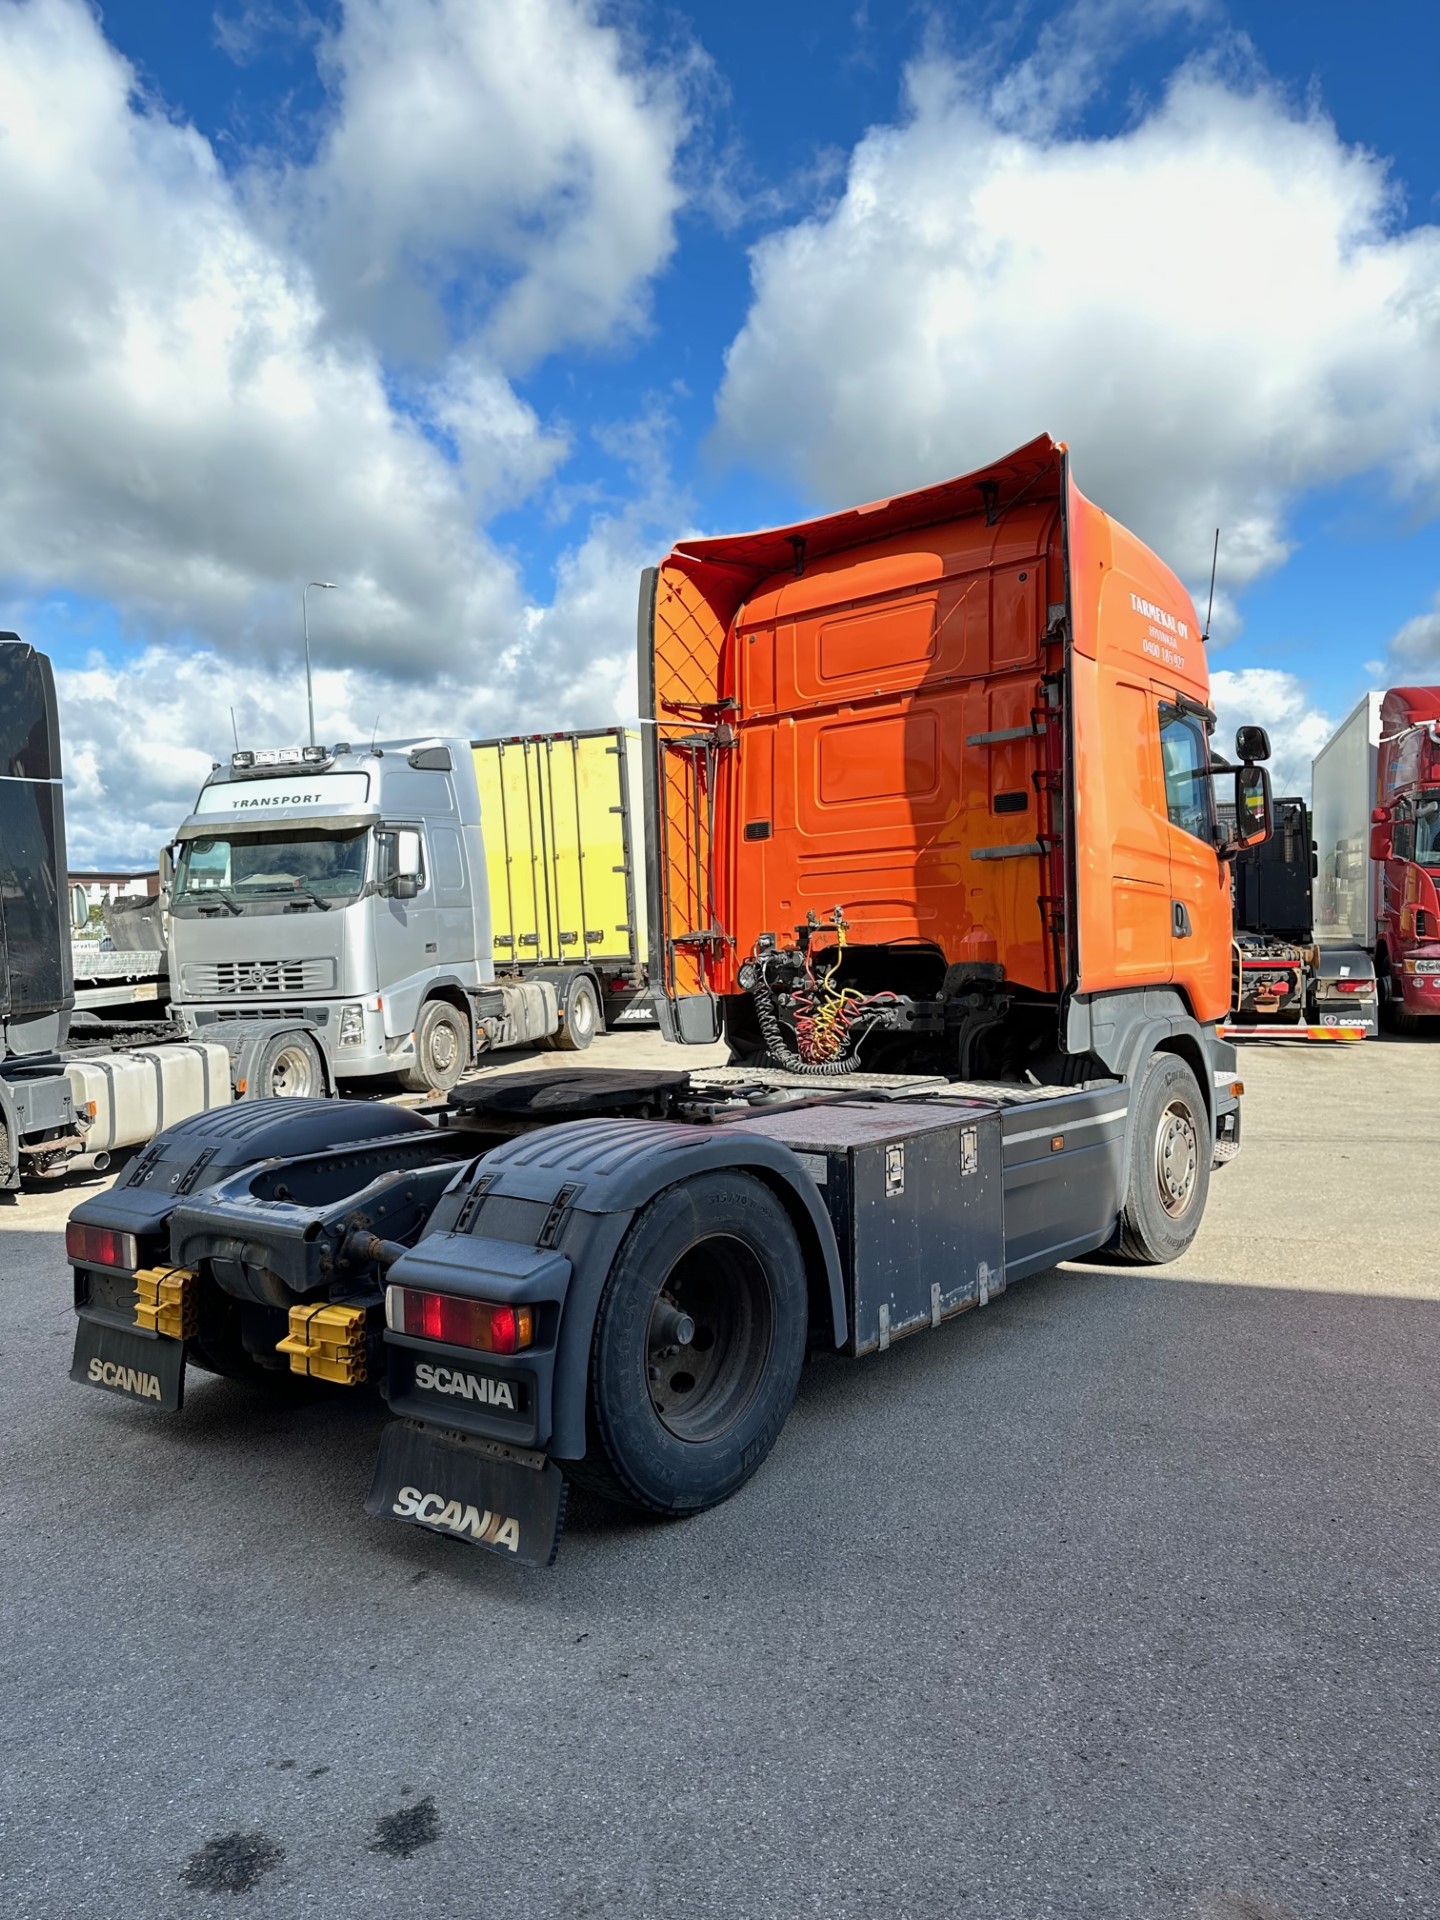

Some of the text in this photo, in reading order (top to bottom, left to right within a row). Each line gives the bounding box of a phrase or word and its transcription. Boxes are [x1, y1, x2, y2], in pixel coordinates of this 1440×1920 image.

[1177, 621, 1189, 640] OY
[232, 794, 322, 808] TRANSPORT
[1339, 1018, 1374, 1026] SCANIA
[88, 1357, 162, 1401] SCANIA
[415, 1363, 515, 1409] SCANIA
[392, 1486, 520, 1553] SCANIA
